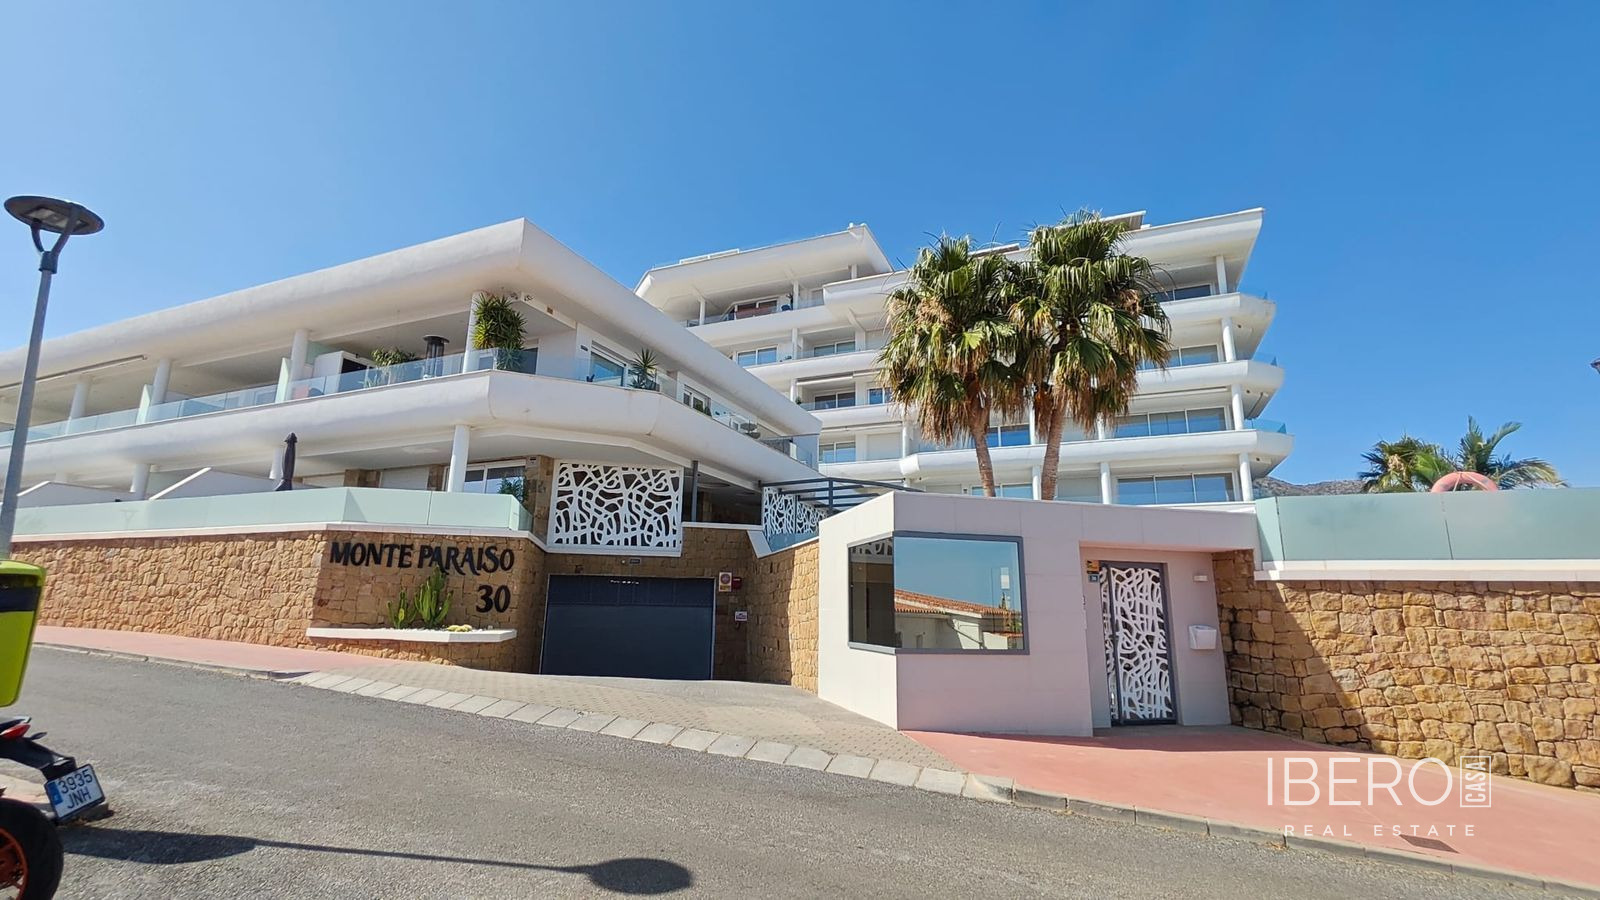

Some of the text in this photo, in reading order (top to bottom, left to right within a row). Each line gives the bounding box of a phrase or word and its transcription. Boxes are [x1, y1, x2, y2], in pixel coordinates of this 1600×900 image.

[329, 541, 515, 576] MONTE PARAISO
[475, 584, 511, 613] 30
[58, 769, 93, 794] 3935
[67, 786, 92, 809] JNH
